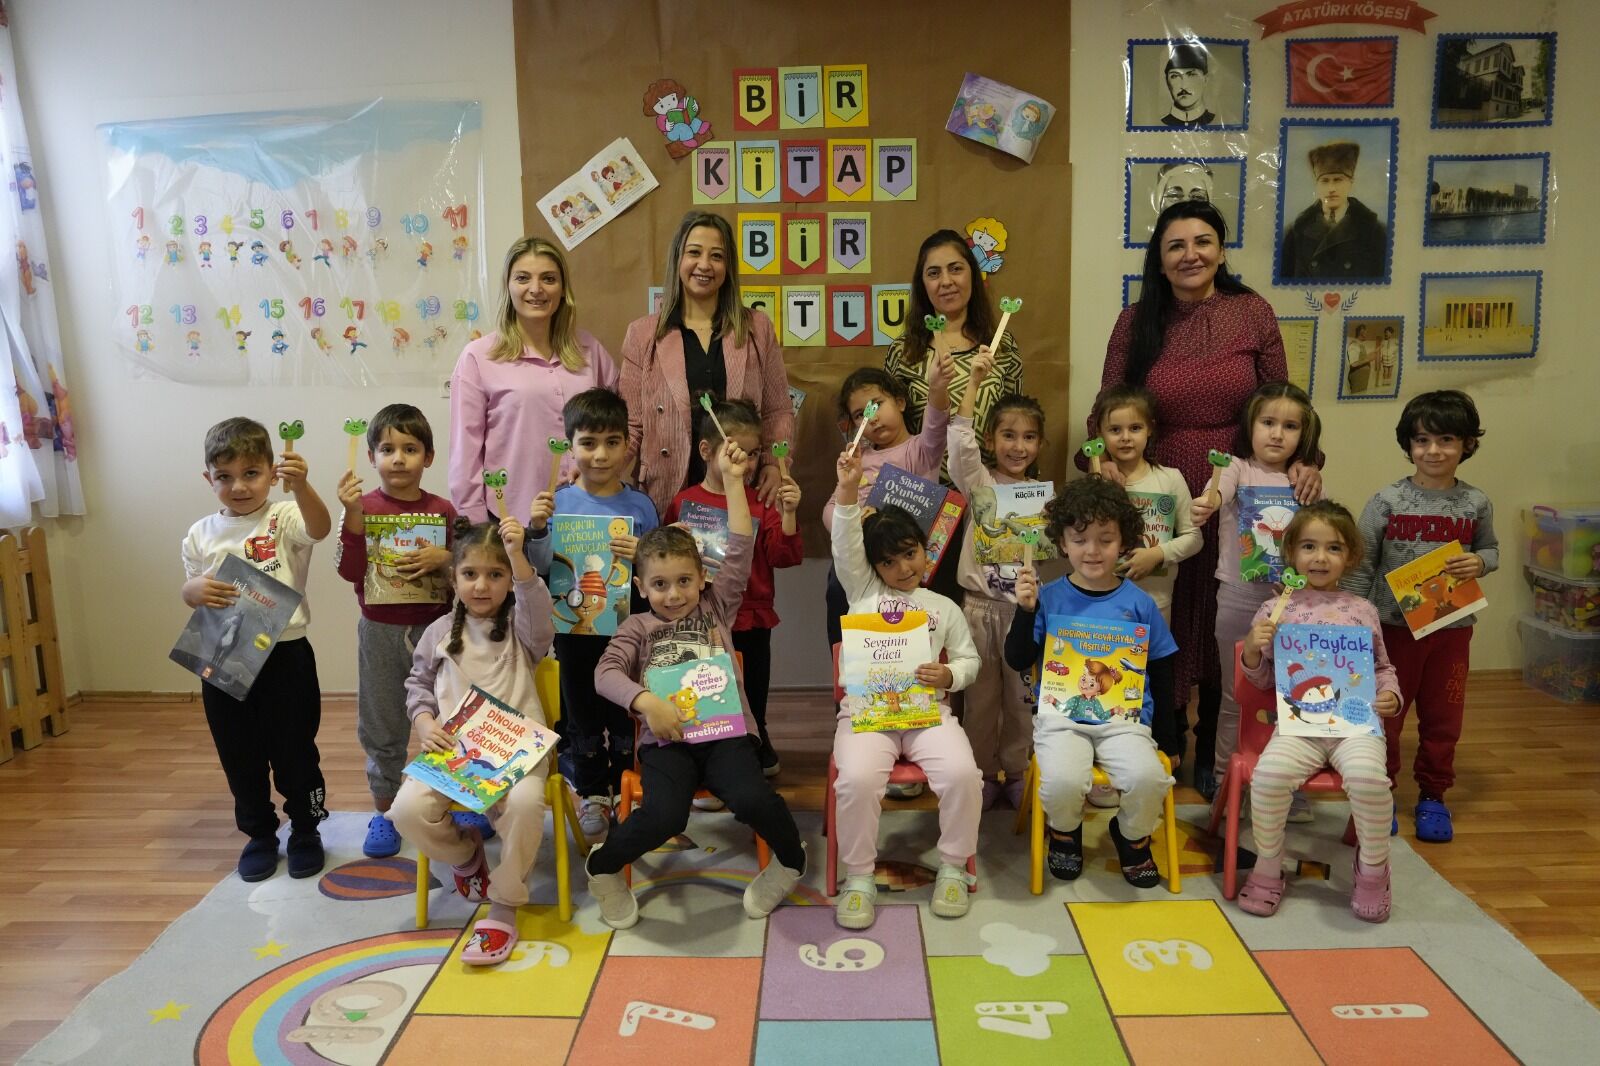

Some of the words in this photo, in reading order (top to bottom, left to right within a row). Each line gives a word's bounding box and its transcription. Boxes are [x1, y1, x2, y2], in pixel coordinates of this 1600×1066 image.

[1282, 4, 1350, 24] ATATÜRK
[1353, 2, 1411, 21] KÖŞESİ
[746, 81, 857, 117] BİR
[704, 154, 906, 191] KİTAP
[131, 207, 144, 230] 1
[168, 214, 184, 236] 2
[194, 215, 208, 235] 3
[220, 214, 234, 235] 4
[250, 208, 265, 230] 5
[281, 209, 295, 230] 6
[335, 207, 348, 230] 8
[366, 206, 382, 228] 9
[401, 213, 429, 234] 10
[442, 204, 468, 231] 11
[750, 228, 860, 262] BİR
[126, 304, 154, 328] 12
[170, 304, 197, 325] 13
[215, 304, 242, 330] 14
[259, 298, 285, 319] 15
[298, 296, 326, 320] 16
[339, 297, 365, 321] 17
[375, 301, 401, 324] 18
[416, 295, 441, 320] 19
[453, 299, 479, 321] 20
[885, 479, 934, 508] Oyuncak
[1015, 491, 1035, 499] Küçük
[1037, 490, 1045, 498] Fil
[863, 636, 908, 652] Sevginin
[872, 649, 902, 661] Gücü
[1280, 635, 1308, 654] Uç,
[1309, 633, 1373, 655] Paytak,
[1334, 654, 1355, 674] Uç
[691, 676, 723, 688] Herkes
[479, 721, 518, 748] SAYMAYI
[486, 709, 526, 738] DİNOLAR
[683, 723, 734, 740] aretliyim
[466, 728, 514, 762] ÖĞRENİYOR
[1122, 938, 1214, 972] 3
[618, 1000, 717, 1037] 7
[974, 1001, 1070, 1040] 4
[1330, 1003, 1430, 1021] 1
